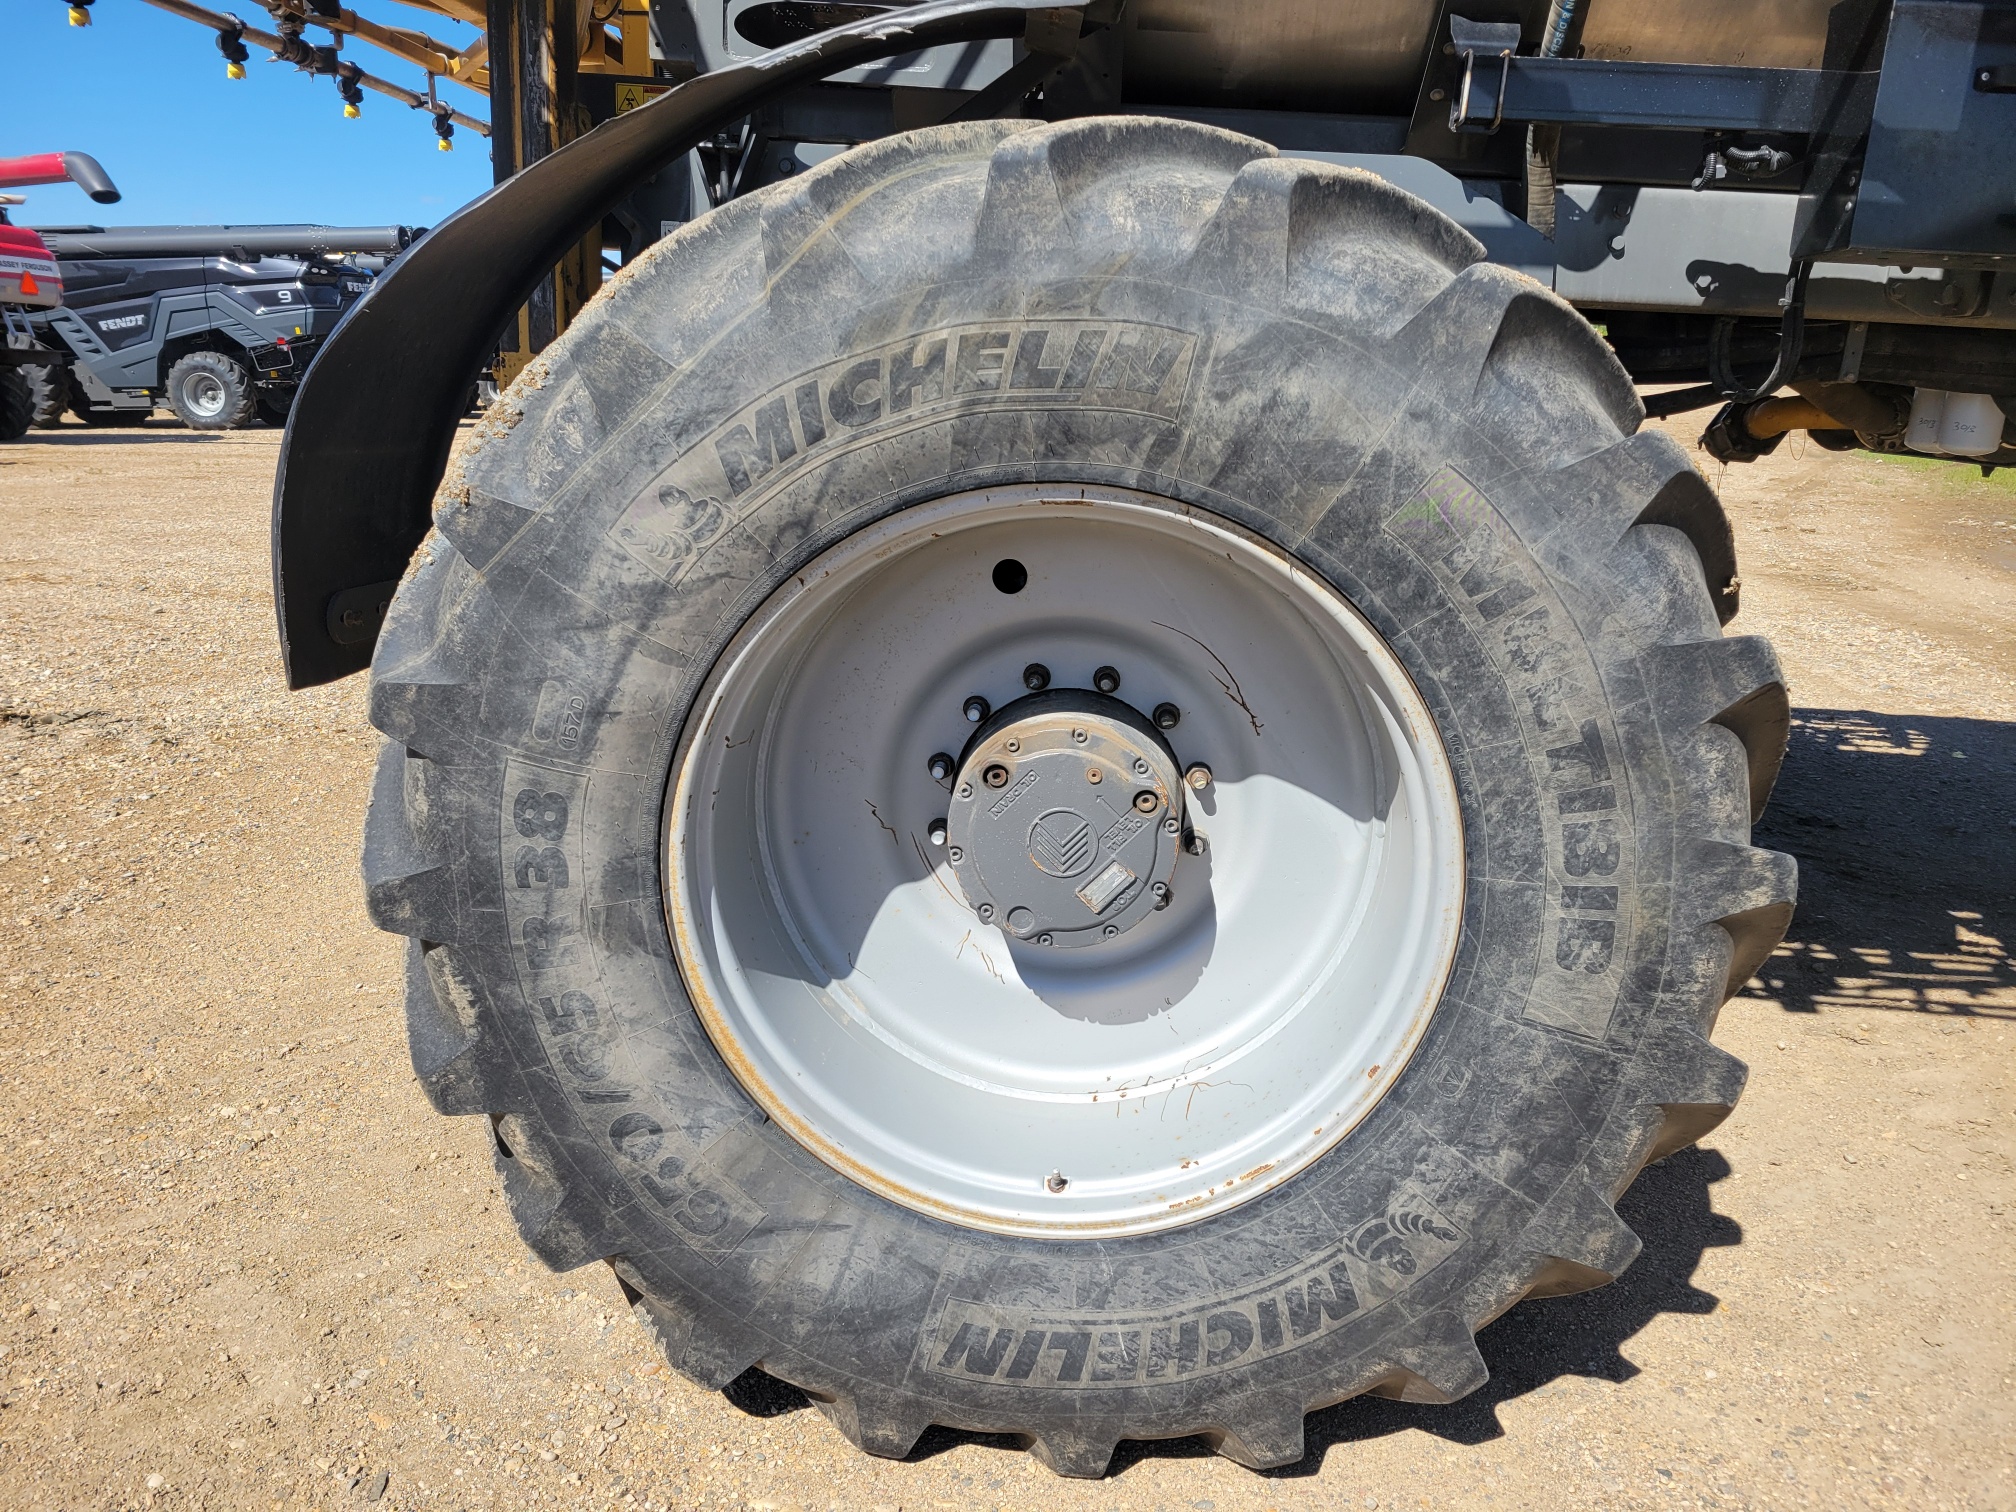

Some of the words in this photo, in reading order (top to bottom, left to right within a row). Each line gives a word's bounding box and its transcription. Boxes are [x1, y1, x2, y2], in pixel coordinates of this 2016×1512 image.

[1549, 21, 1568, 57] DISCHA
[0, 259, 19, 268] ASSEY
[21, 261, 53, 272] FERGUSON
[278, 290, 292, 303] 9
[347, 281, 372, 292] FEND
[98, 314, 145, 331] FENDT
[714, 329, 1189, 498] MICHELIN
[991, 789, 1022, 816] DRAIN
[512, 786, 571, 891] 38
[1104, 815, 1133, 843] LEVEL
[1106, 833, 1127, 853] FILL
[1112, 889, 1137, 911] TOP
[937, 1257, 1363, 1383] MICHELIN
